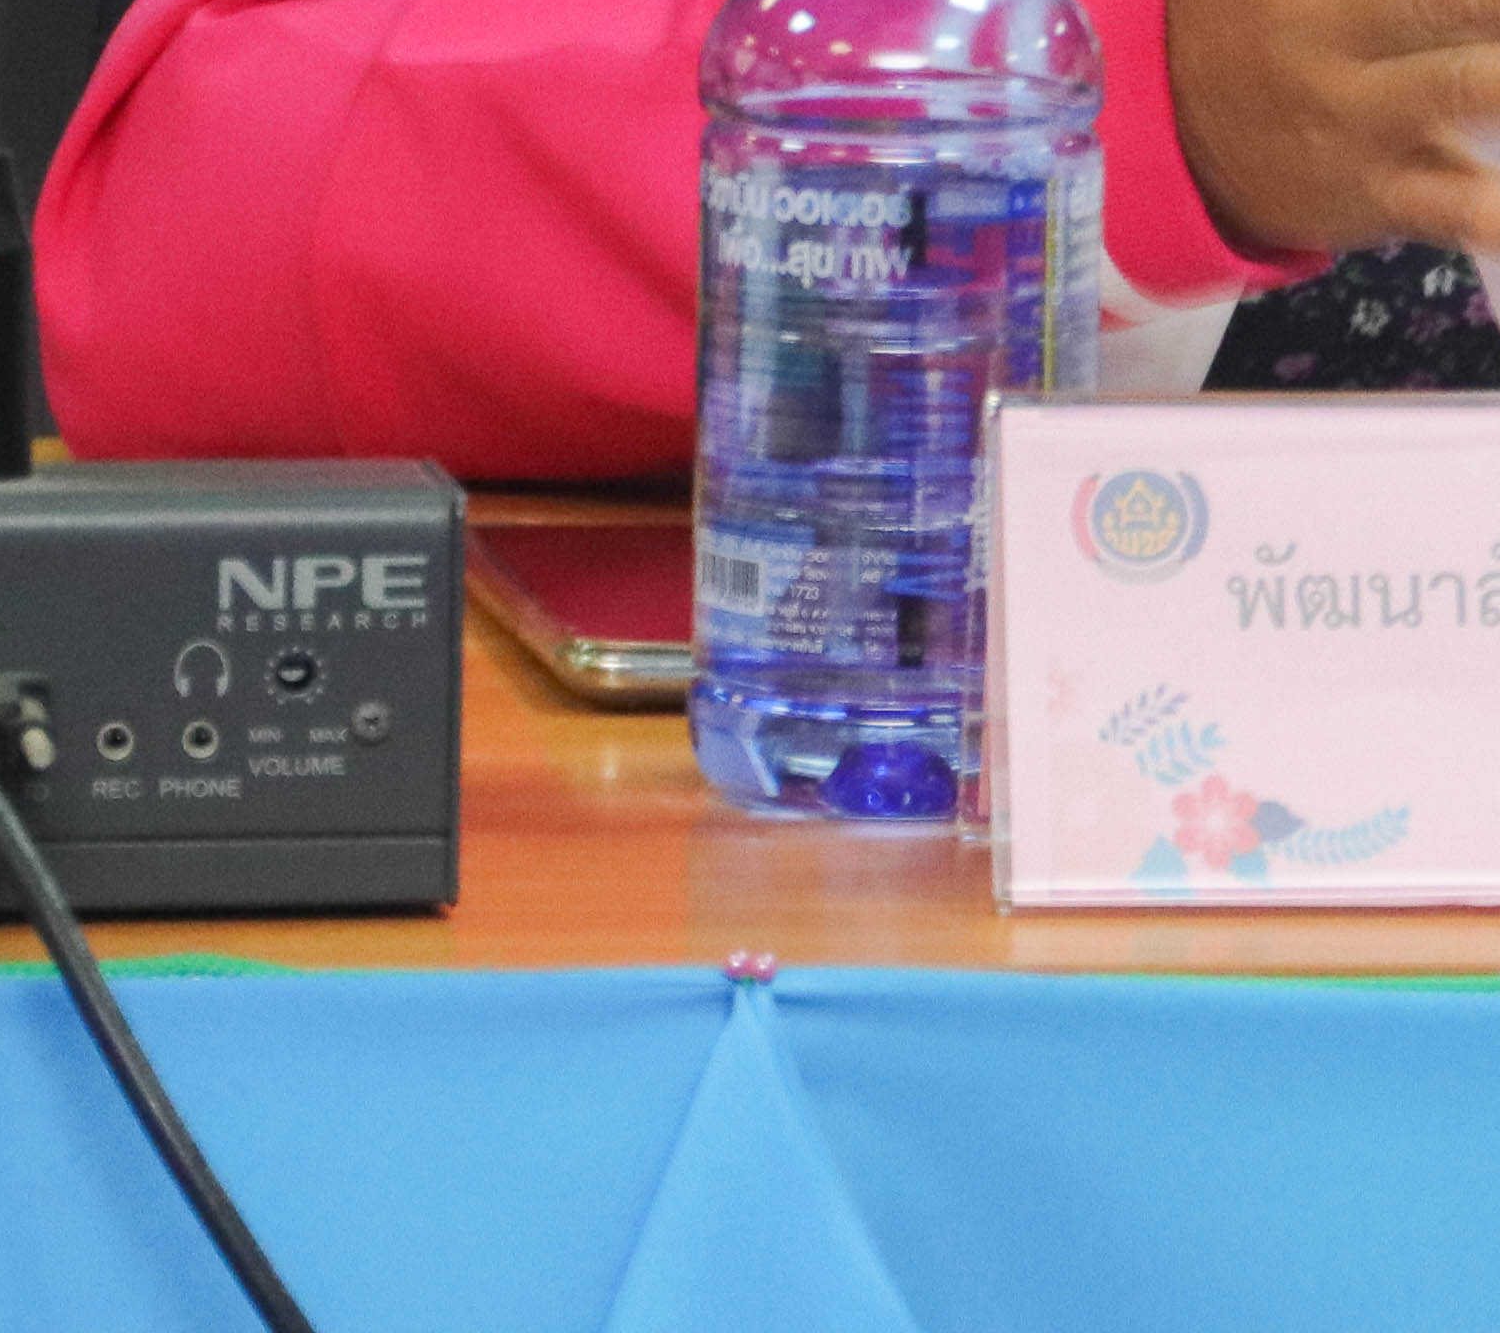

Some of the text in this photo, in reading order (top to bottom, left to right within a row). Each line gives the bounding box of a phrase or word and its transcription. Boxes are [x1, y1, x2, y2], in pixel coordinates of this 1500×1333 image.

[217, 554, 429, 610] NPE
[216, 612, 428, 632] RESEARCH
[248, 727, 281, 744] MIN
[309, 727, 348, 744] MAX
[248, 755, 345, 778] VOLUME
[92, 779, 140, 800] REC
[159, 778, 241, 799] PHONE
